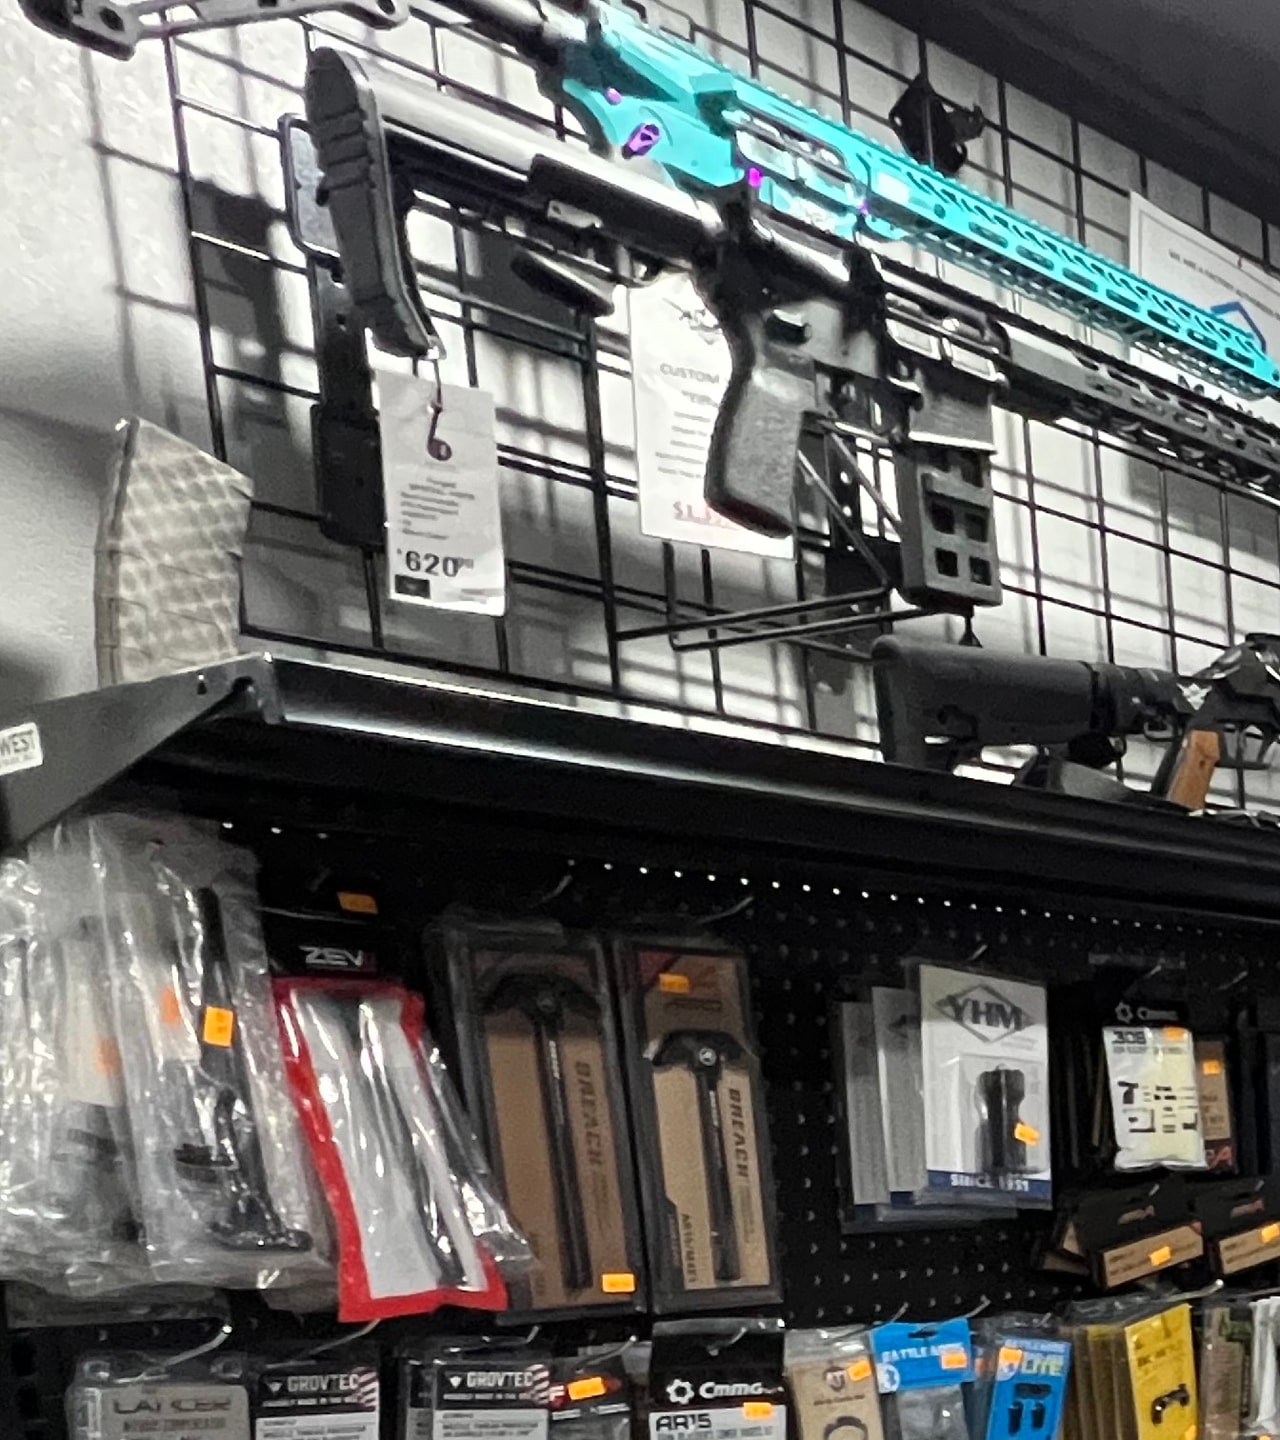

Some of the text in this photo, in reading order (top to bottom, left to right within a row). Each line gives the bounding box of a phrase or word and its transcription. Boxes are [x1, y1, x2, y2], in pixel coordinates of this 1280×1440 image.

[299, 945, 364, 967] ZEV
[947, 995, 1026, 1033] YHM
[727, 1087, 750, 1179] BREACH
[287, 1373, 360, 1393] GROVTEC
[466, 1371, 534, 1389] GROVTEC
[656, 1412, 712, 1432] AR15
